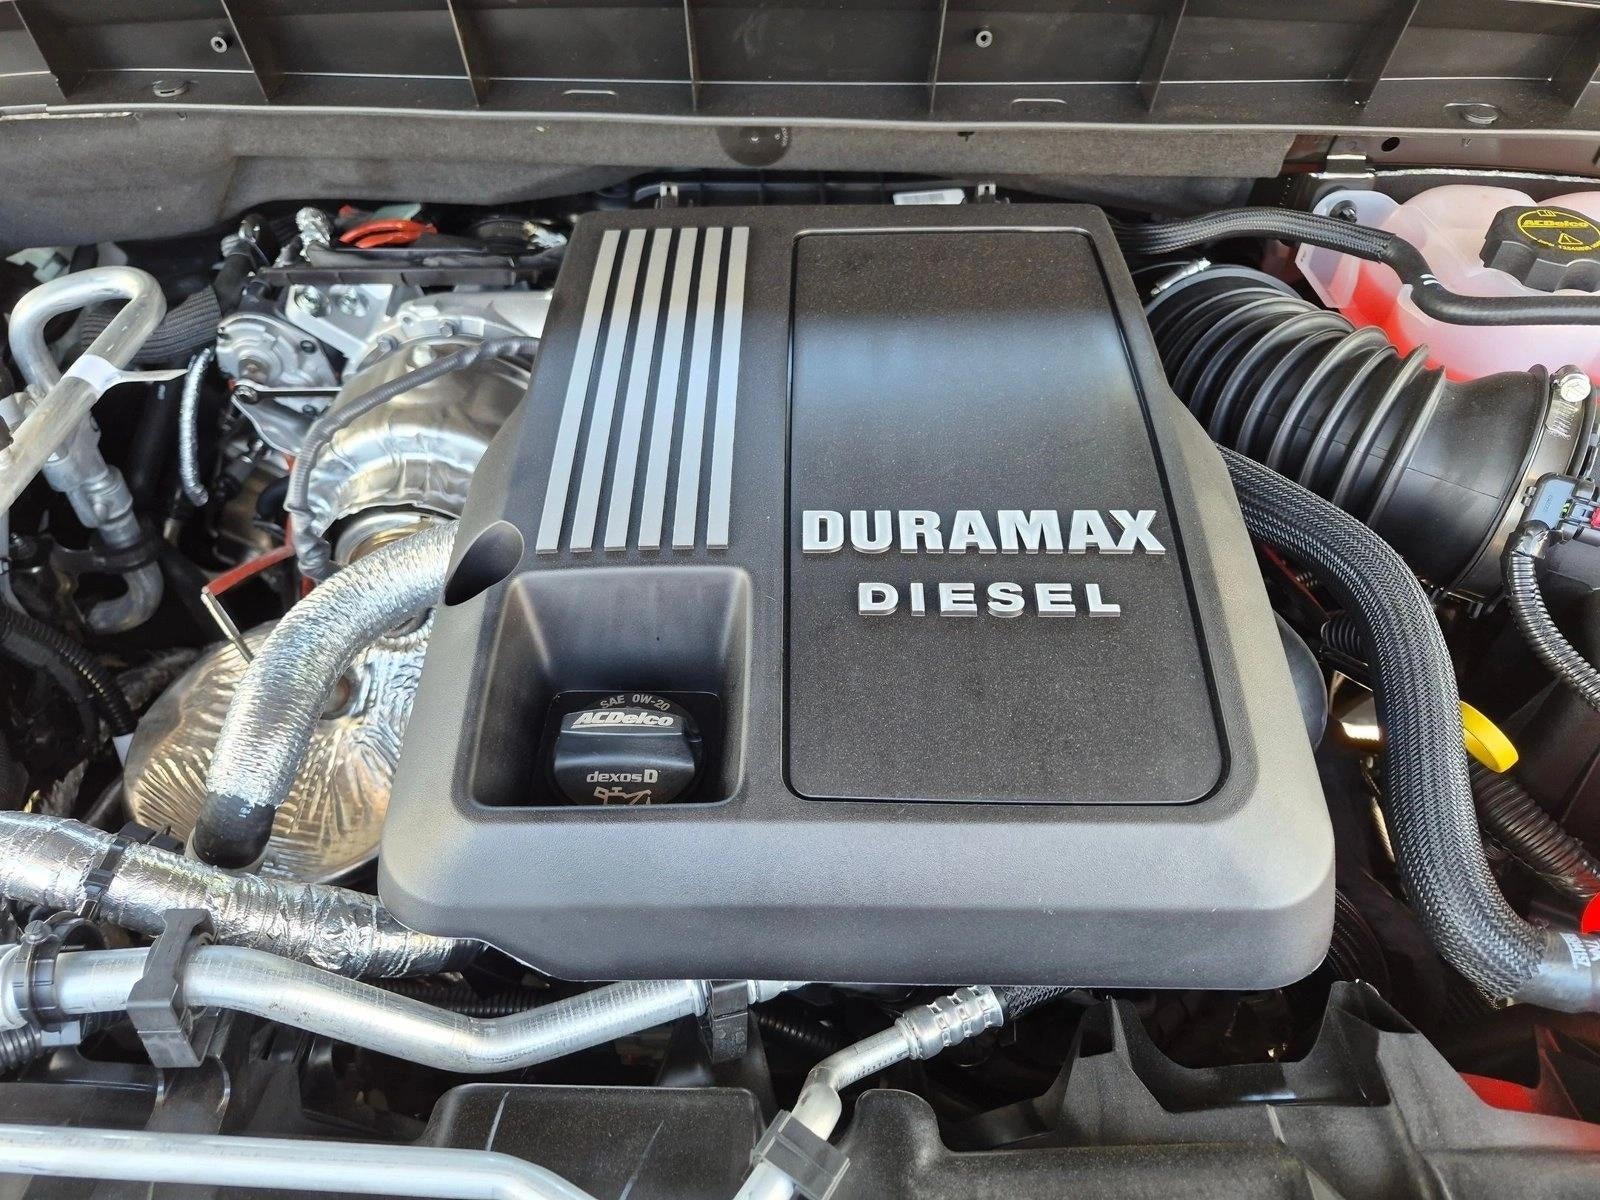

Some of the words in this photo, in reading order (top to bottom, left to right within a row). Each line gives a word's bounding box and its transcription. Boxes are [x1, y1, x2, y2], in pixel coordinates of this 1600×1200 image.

[802, 510, 1166, 554] DURAMAX
[858, 582, 1121, 617] DIESEL
[600, 694, 625, 709] SAE
[632, 694, 670, 711] 0W-20
[572, 711, 674, 727] ACDelco
